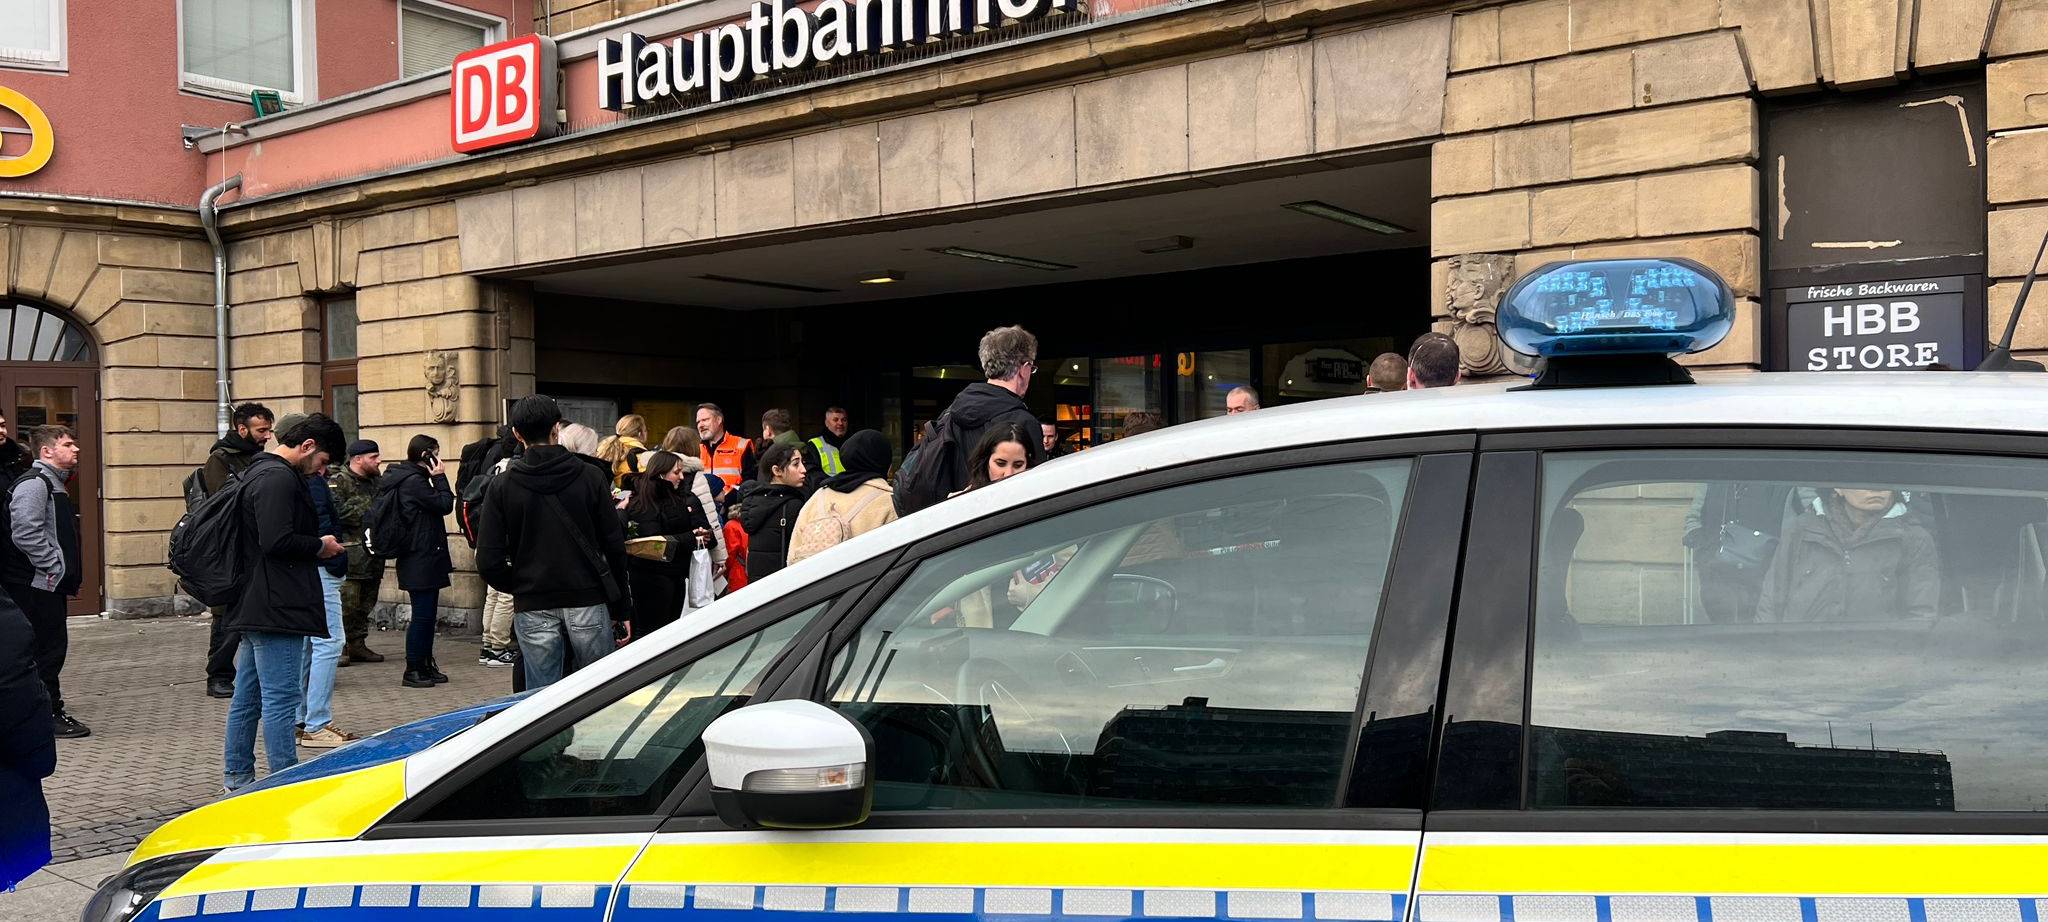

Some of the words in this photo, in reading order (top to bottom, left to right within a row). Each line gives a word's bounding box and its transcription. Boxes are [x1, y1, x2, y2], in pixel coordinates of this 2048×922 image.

[598, 0, 1066, 109] Hauptbahn
[461, 57, 527, 134] DB
[1807, 286, 1853, 299] frische
[1858, 281, 1939, 296] Backwaren
[1824, 301, 1921, 337] HBB
[1807, 342, 1939, 371] STORE
